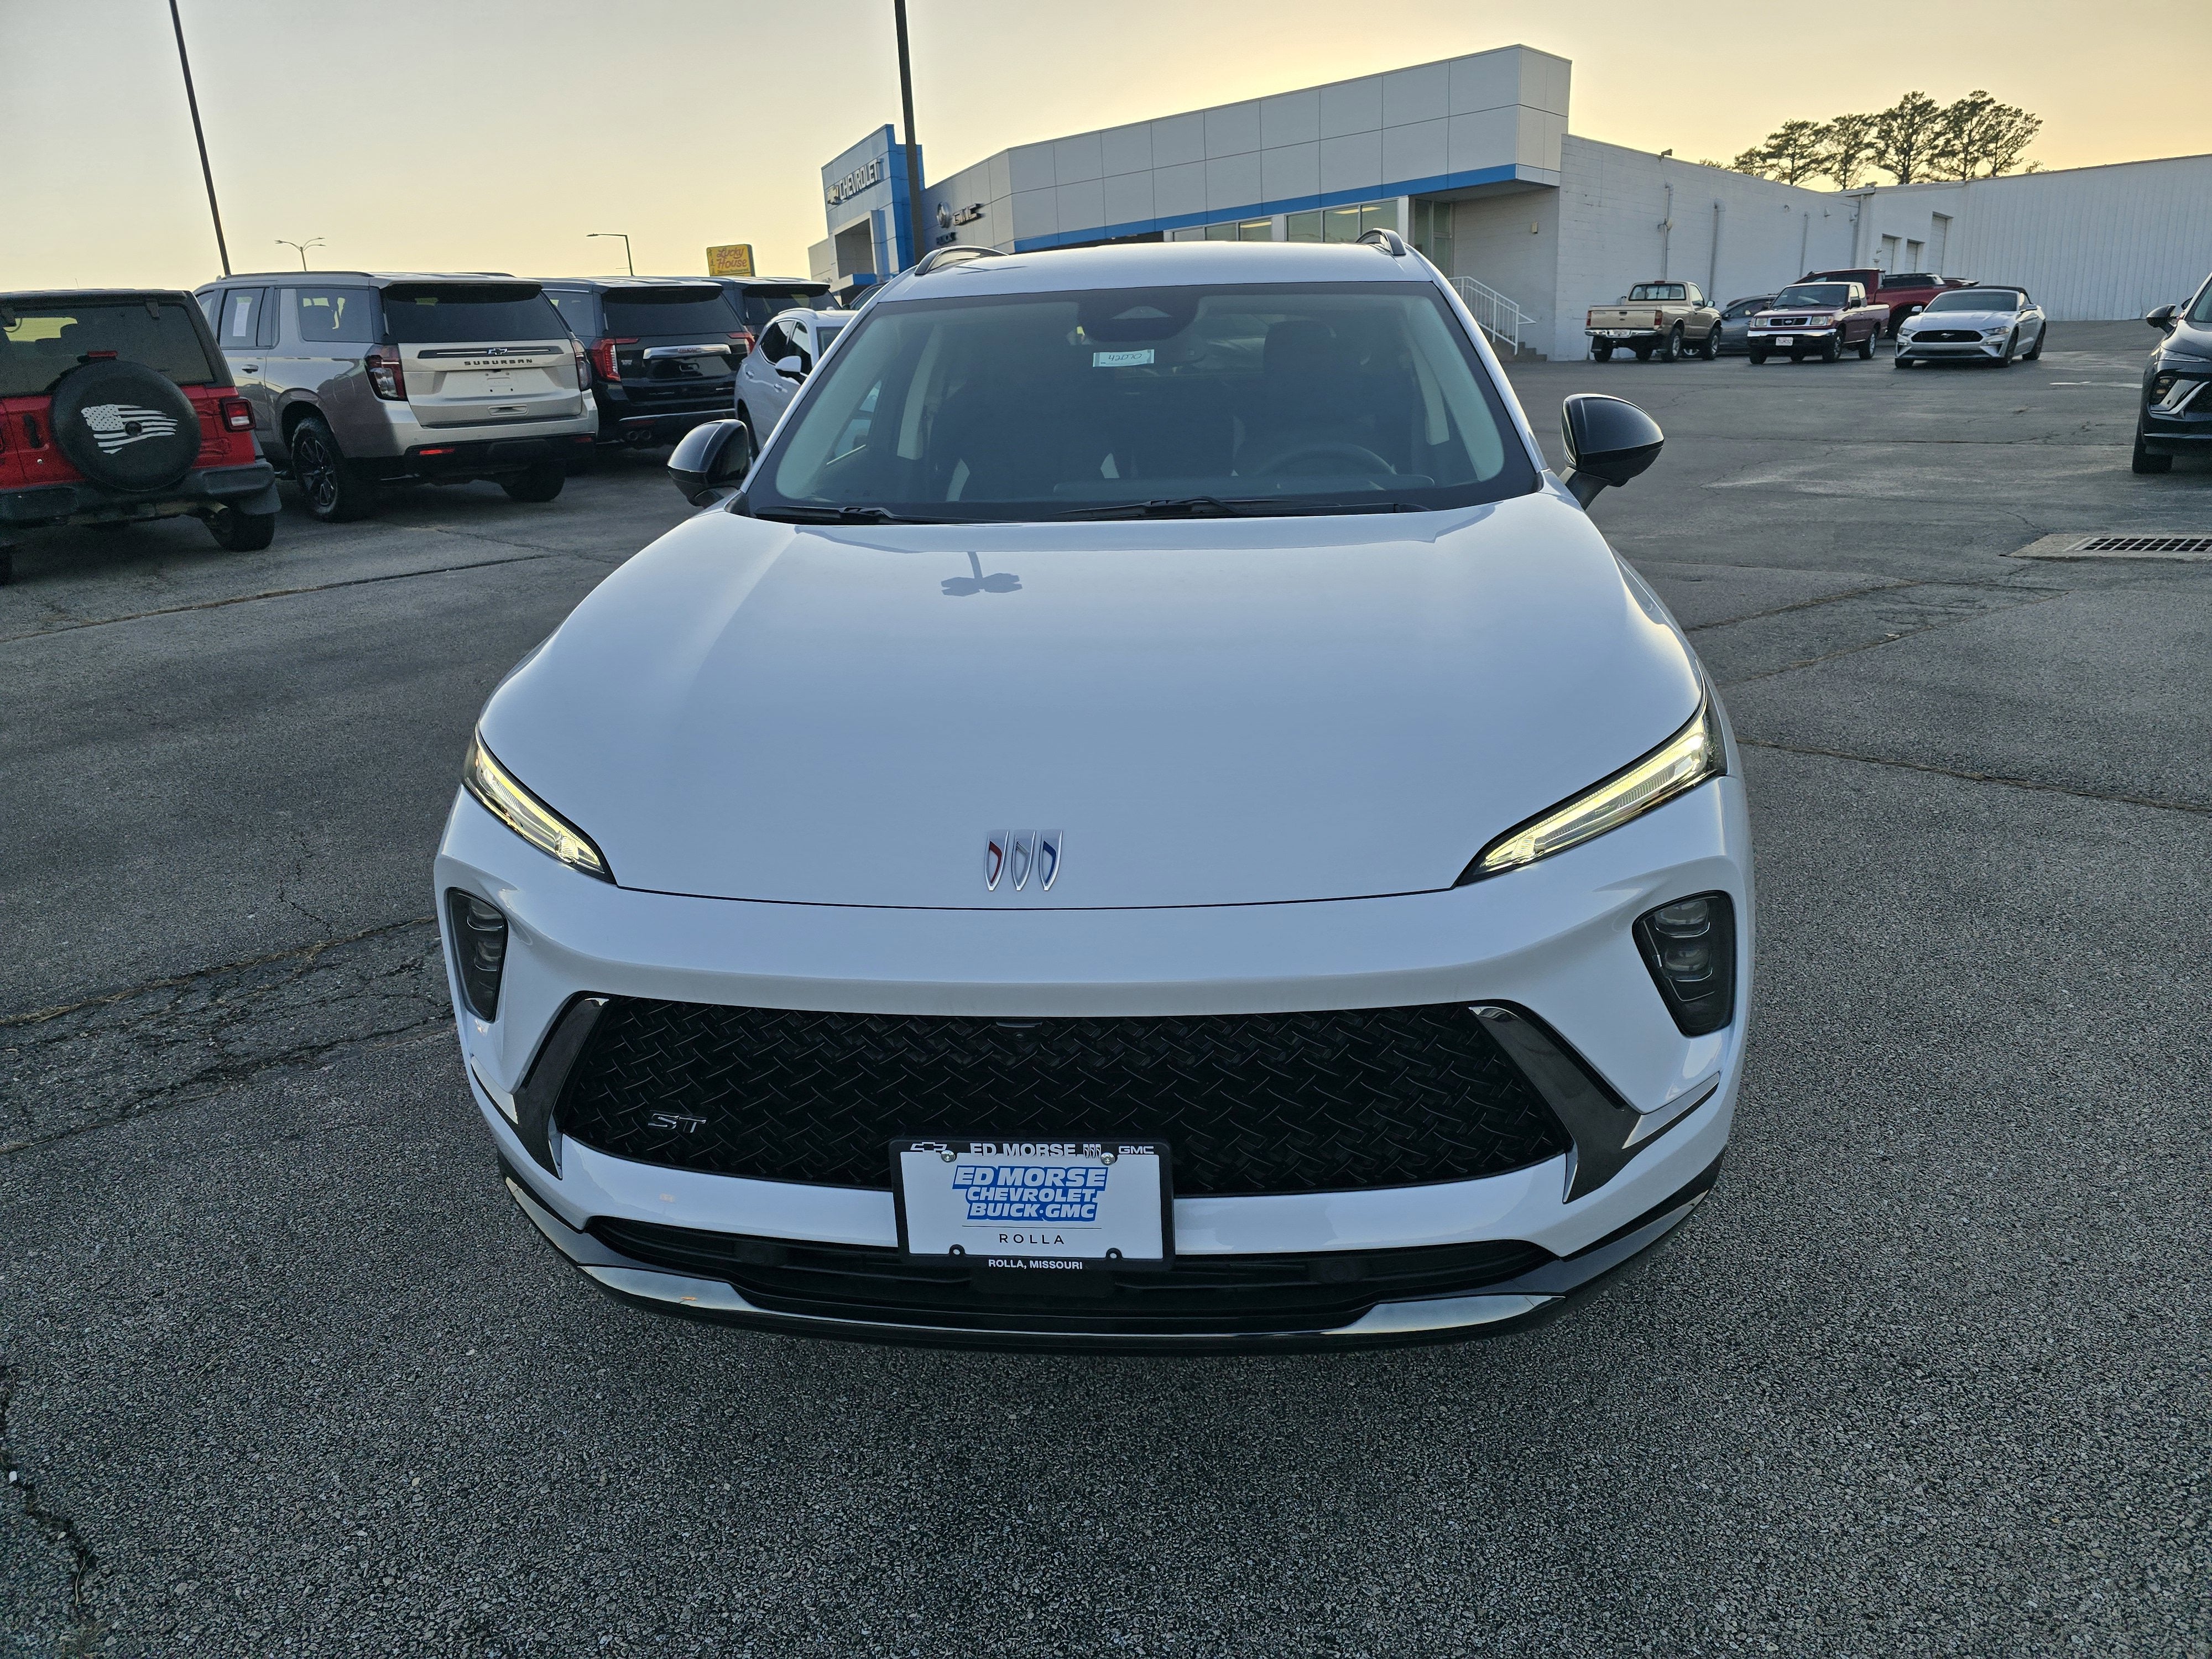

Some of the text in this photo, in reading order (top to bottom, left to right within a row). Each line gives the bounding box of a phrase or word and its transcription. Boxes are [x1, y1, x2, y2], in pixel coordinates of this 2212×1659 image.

[839, 158, 880, 200] CHEVROLET
[952, 202, 981, 226] GMC
[717, 247, 744, 259] Lucky
[717, 258, 747, 269] House
[647, 1113, 707, 1133] ST
[970, 1142, 1155, 1158] ED MORSE GMC
[954, 1167, 1107, 1187] ED MORSE
[967, 1186, 1095, 1202] CHEVROLET
[999, 1234, 1065, 1245] ROLLA
[988, 1259, 1083, 1270] ROLLA, MISSOURI
